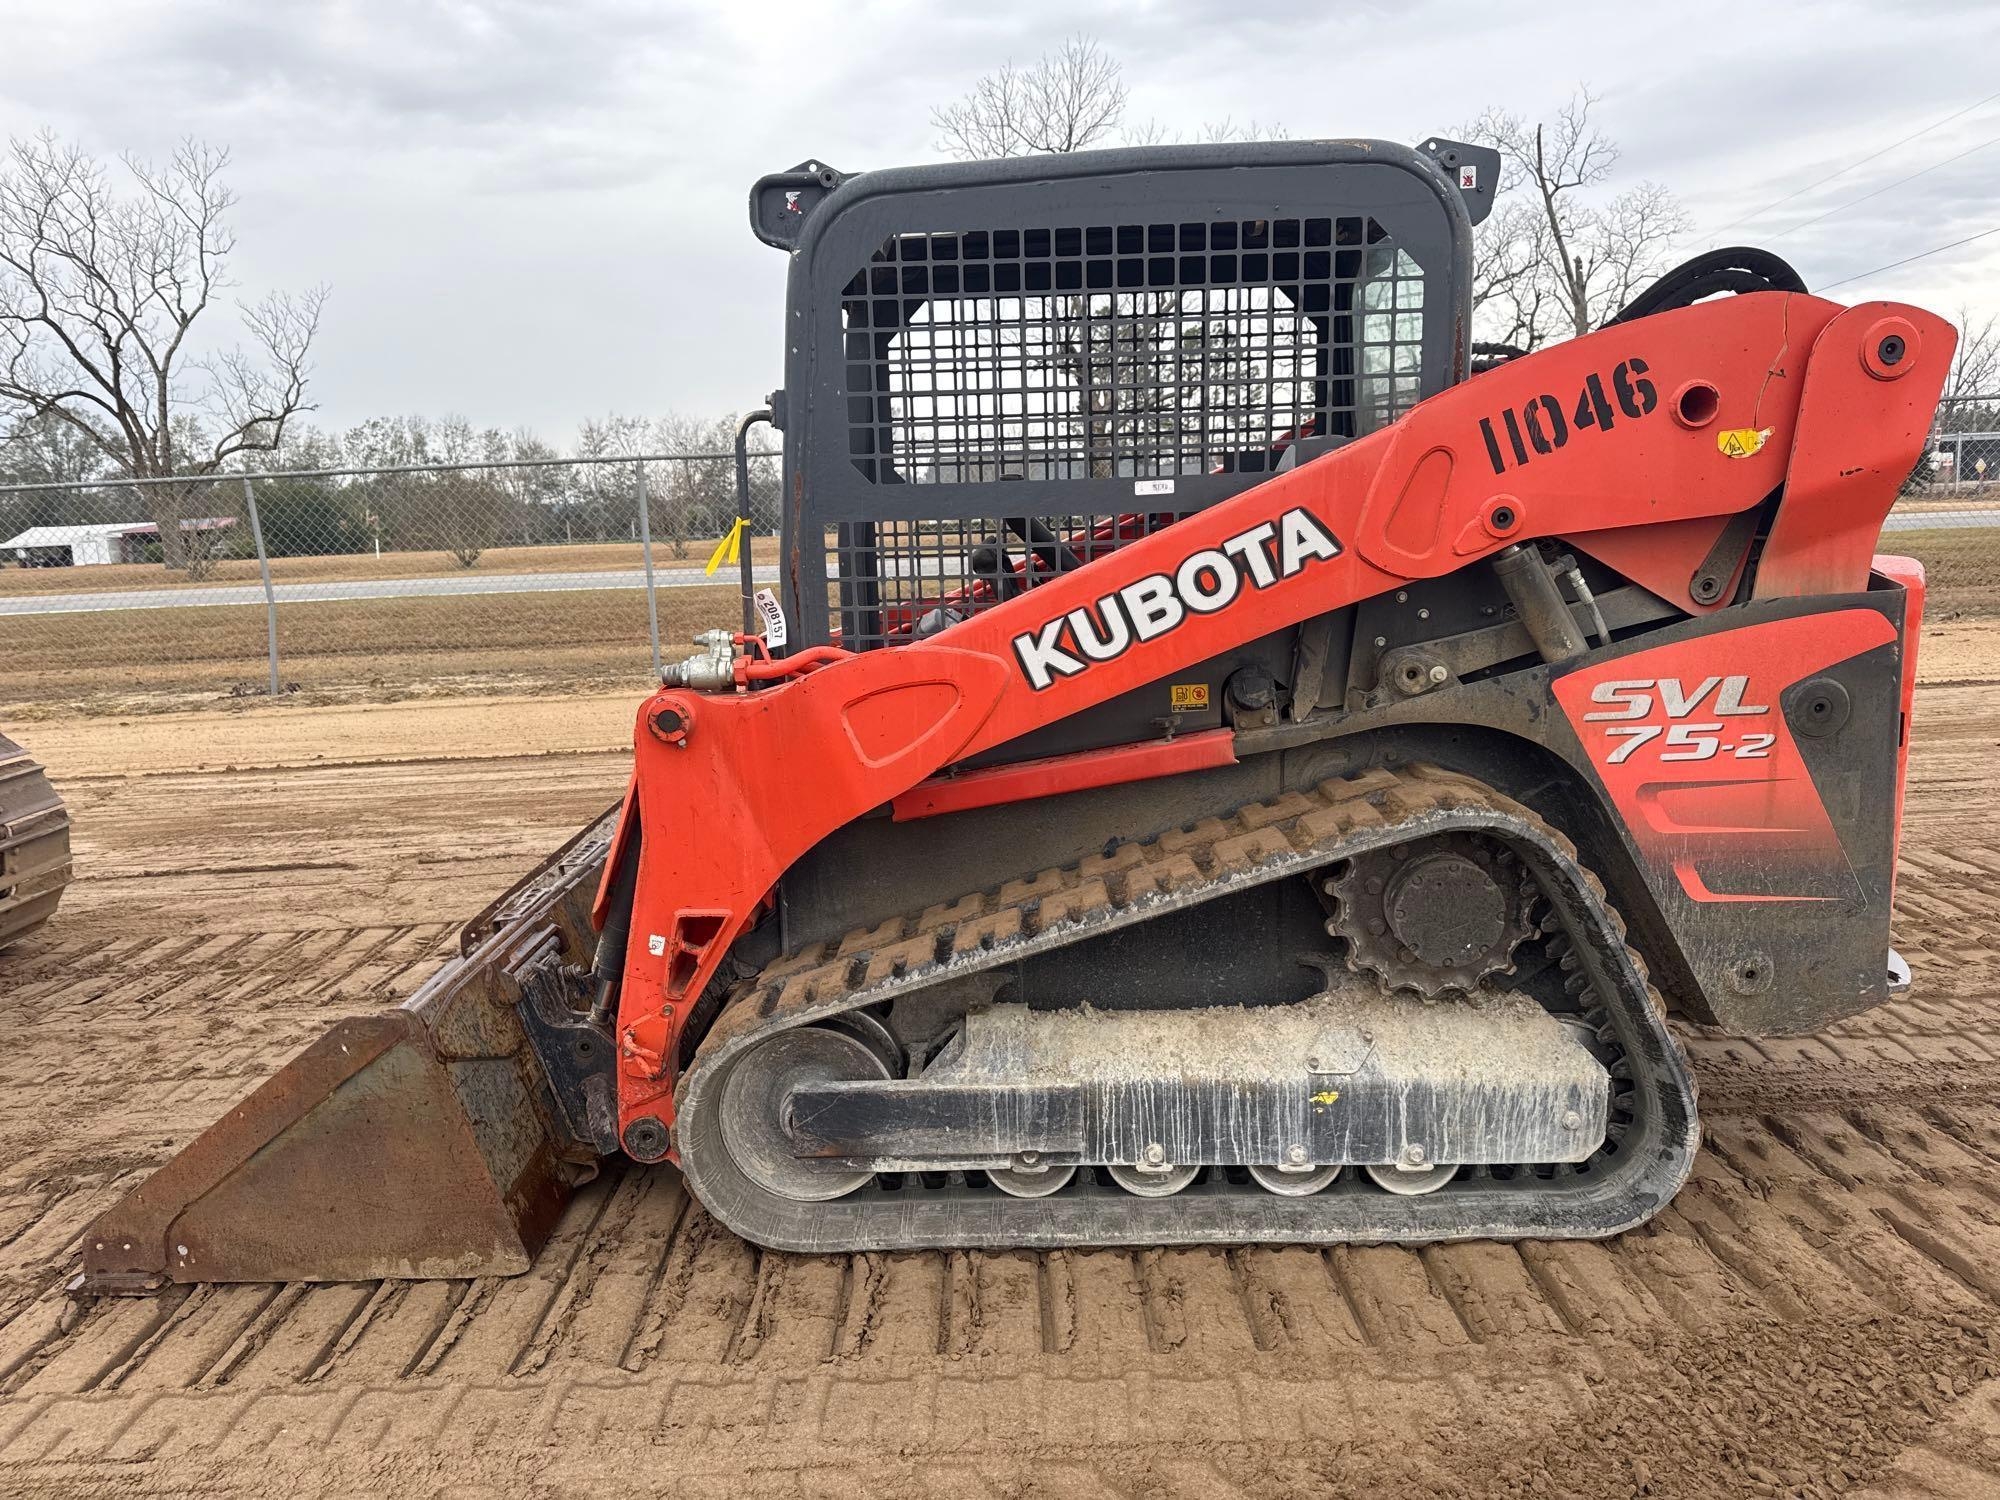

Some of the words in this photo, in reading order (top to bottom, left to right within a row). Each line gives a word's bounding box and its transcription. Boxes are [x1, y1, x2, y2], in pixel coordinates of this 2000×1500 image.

[1478, 358, 1658, 475] 11046
[763, 601, 783, 638] 208157
[1012, 506, 1344, 691] KUBOTA
[1583, 675, 1770, 721] SVL
[1605, 723, 1776, 764] 75-2
